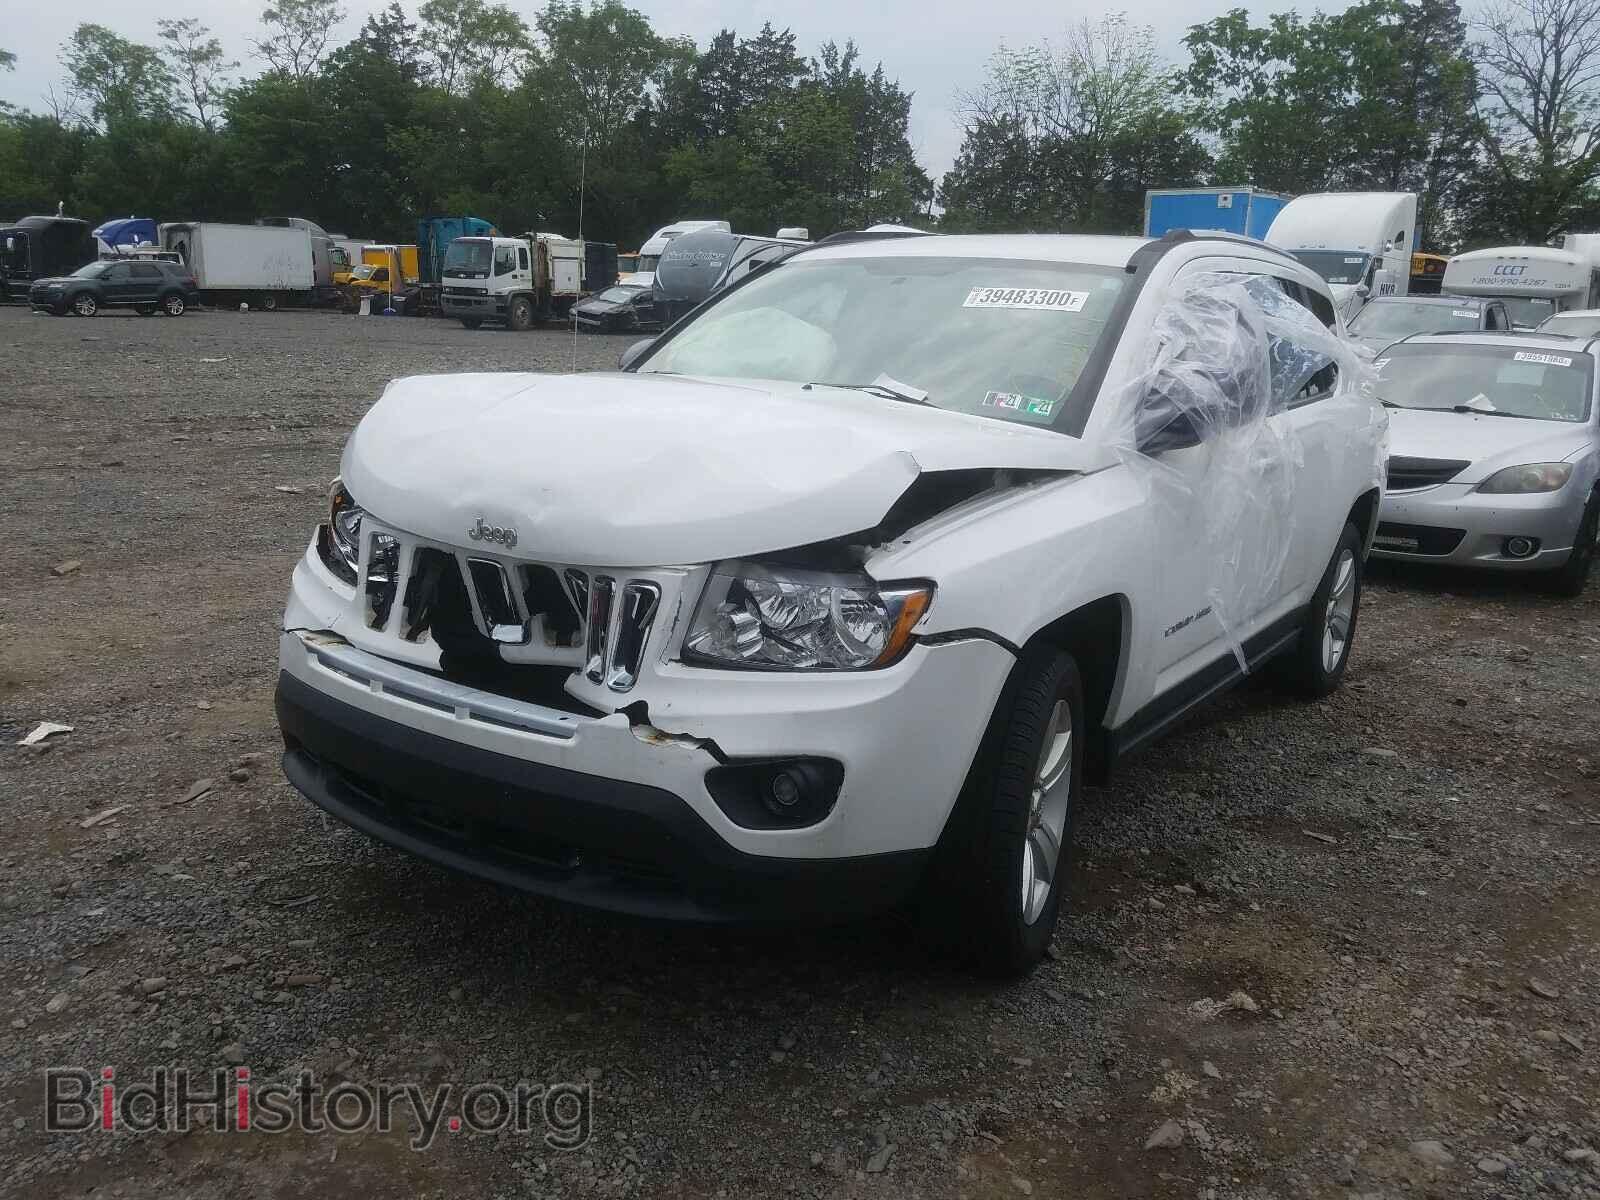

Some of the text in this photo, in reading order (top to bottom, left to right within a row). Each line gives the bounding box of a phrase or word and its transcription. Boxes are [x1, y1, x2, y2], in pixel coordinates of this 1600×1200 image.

[1493, 265, 1528, 275] CCCT
[980, 289, 1072, 306] 39483300
[468, 517, 518, 549] Jeep
